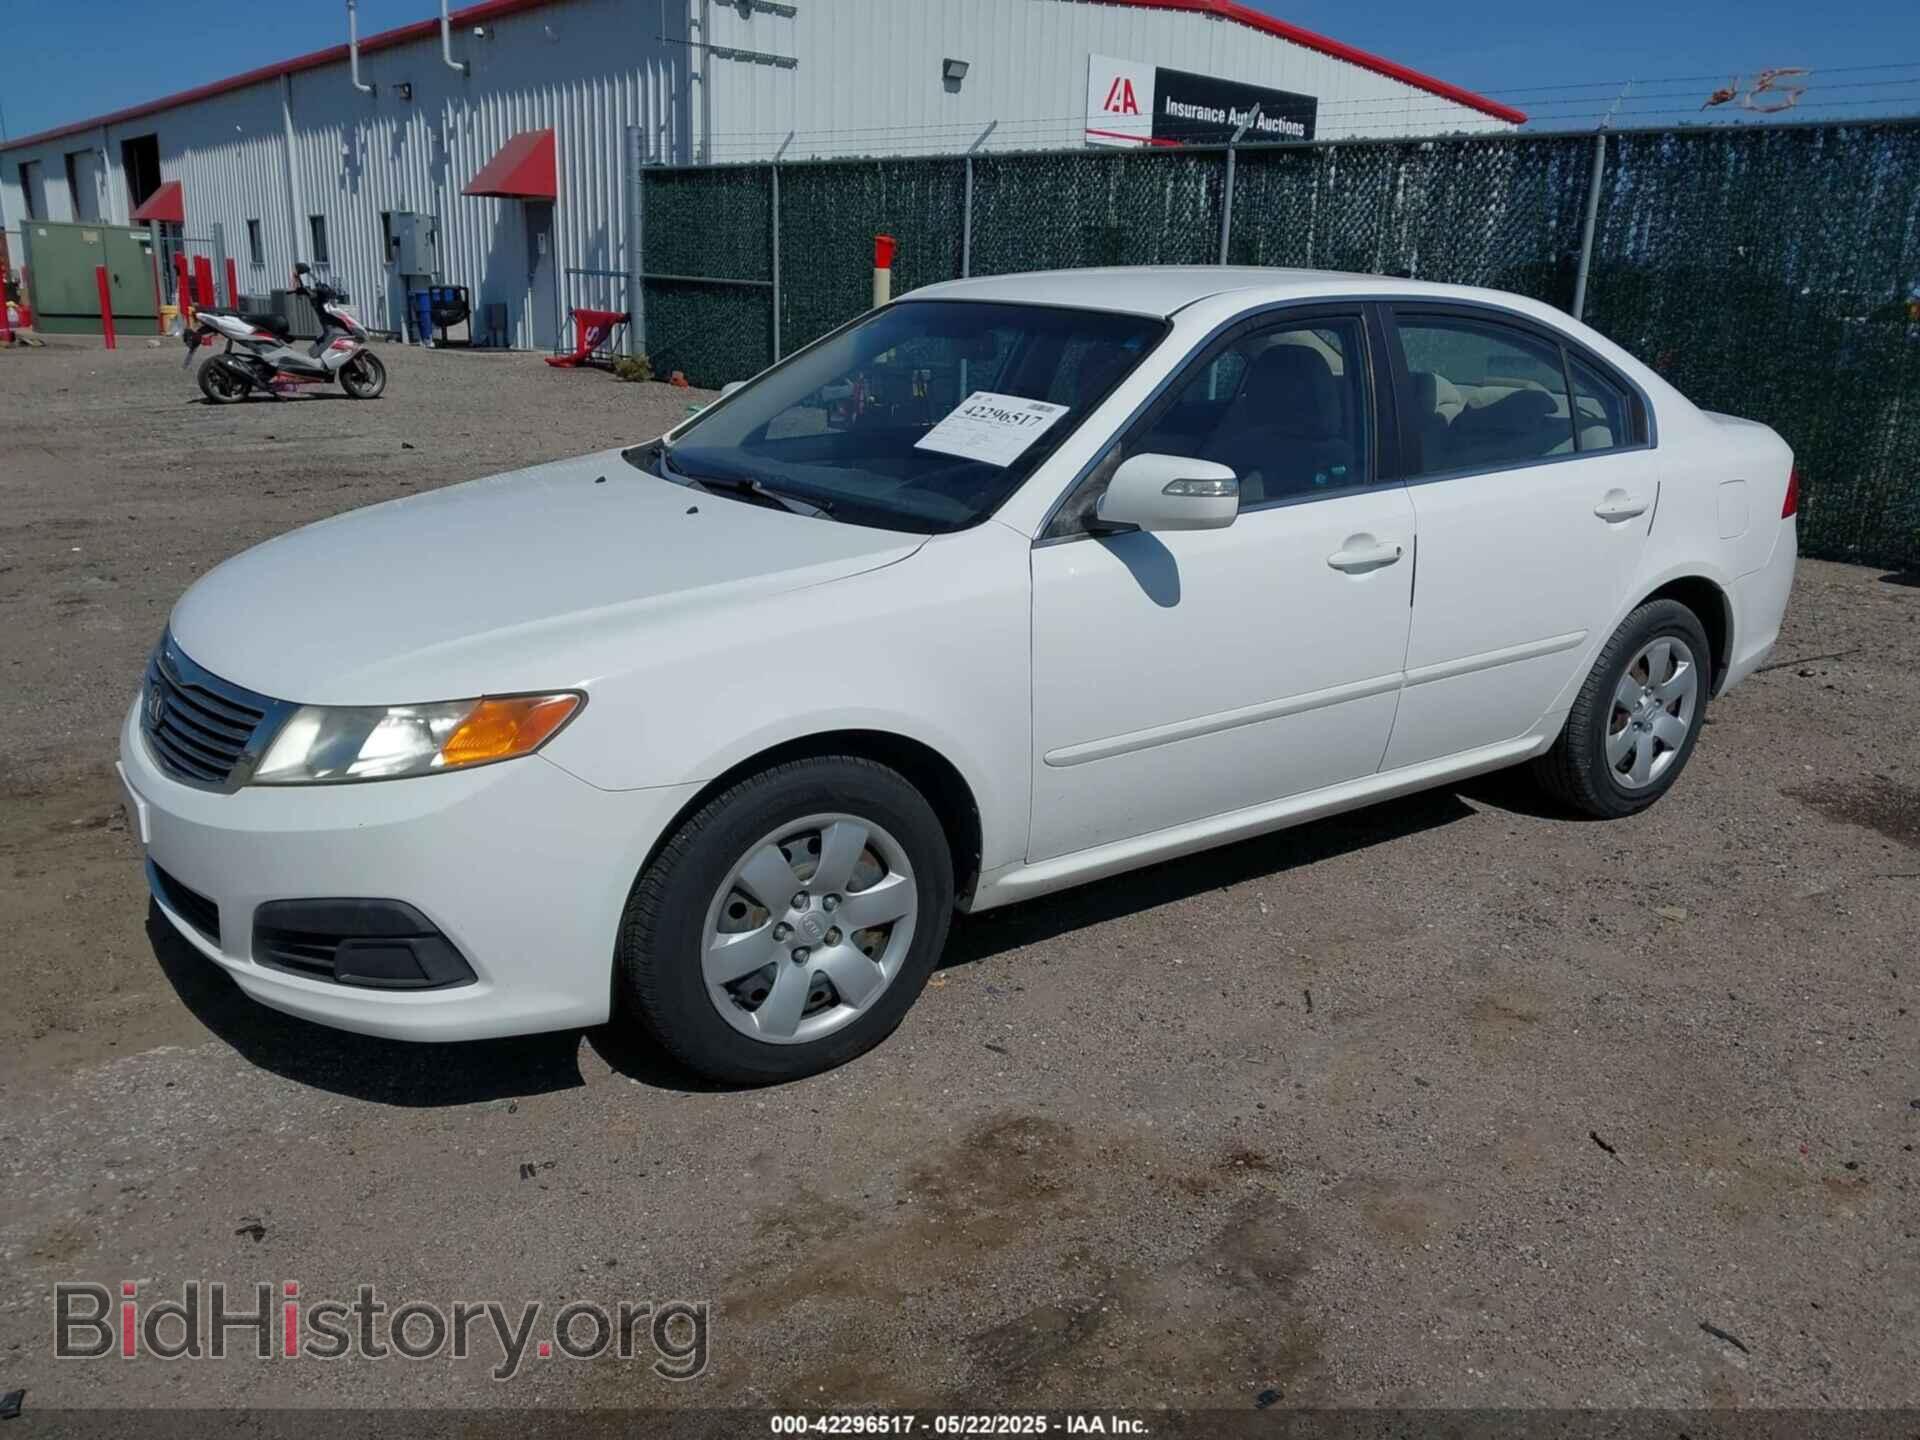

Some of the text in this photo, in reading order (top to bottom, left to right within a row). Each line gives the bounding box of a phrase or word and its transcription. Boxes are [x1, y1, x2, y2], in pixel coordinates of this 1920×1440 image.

[1165, 96, 1225, 124] Insurance
[1256, 114, 1305, 137] Auctions
[964, 406, 1043, 428] 42296517
